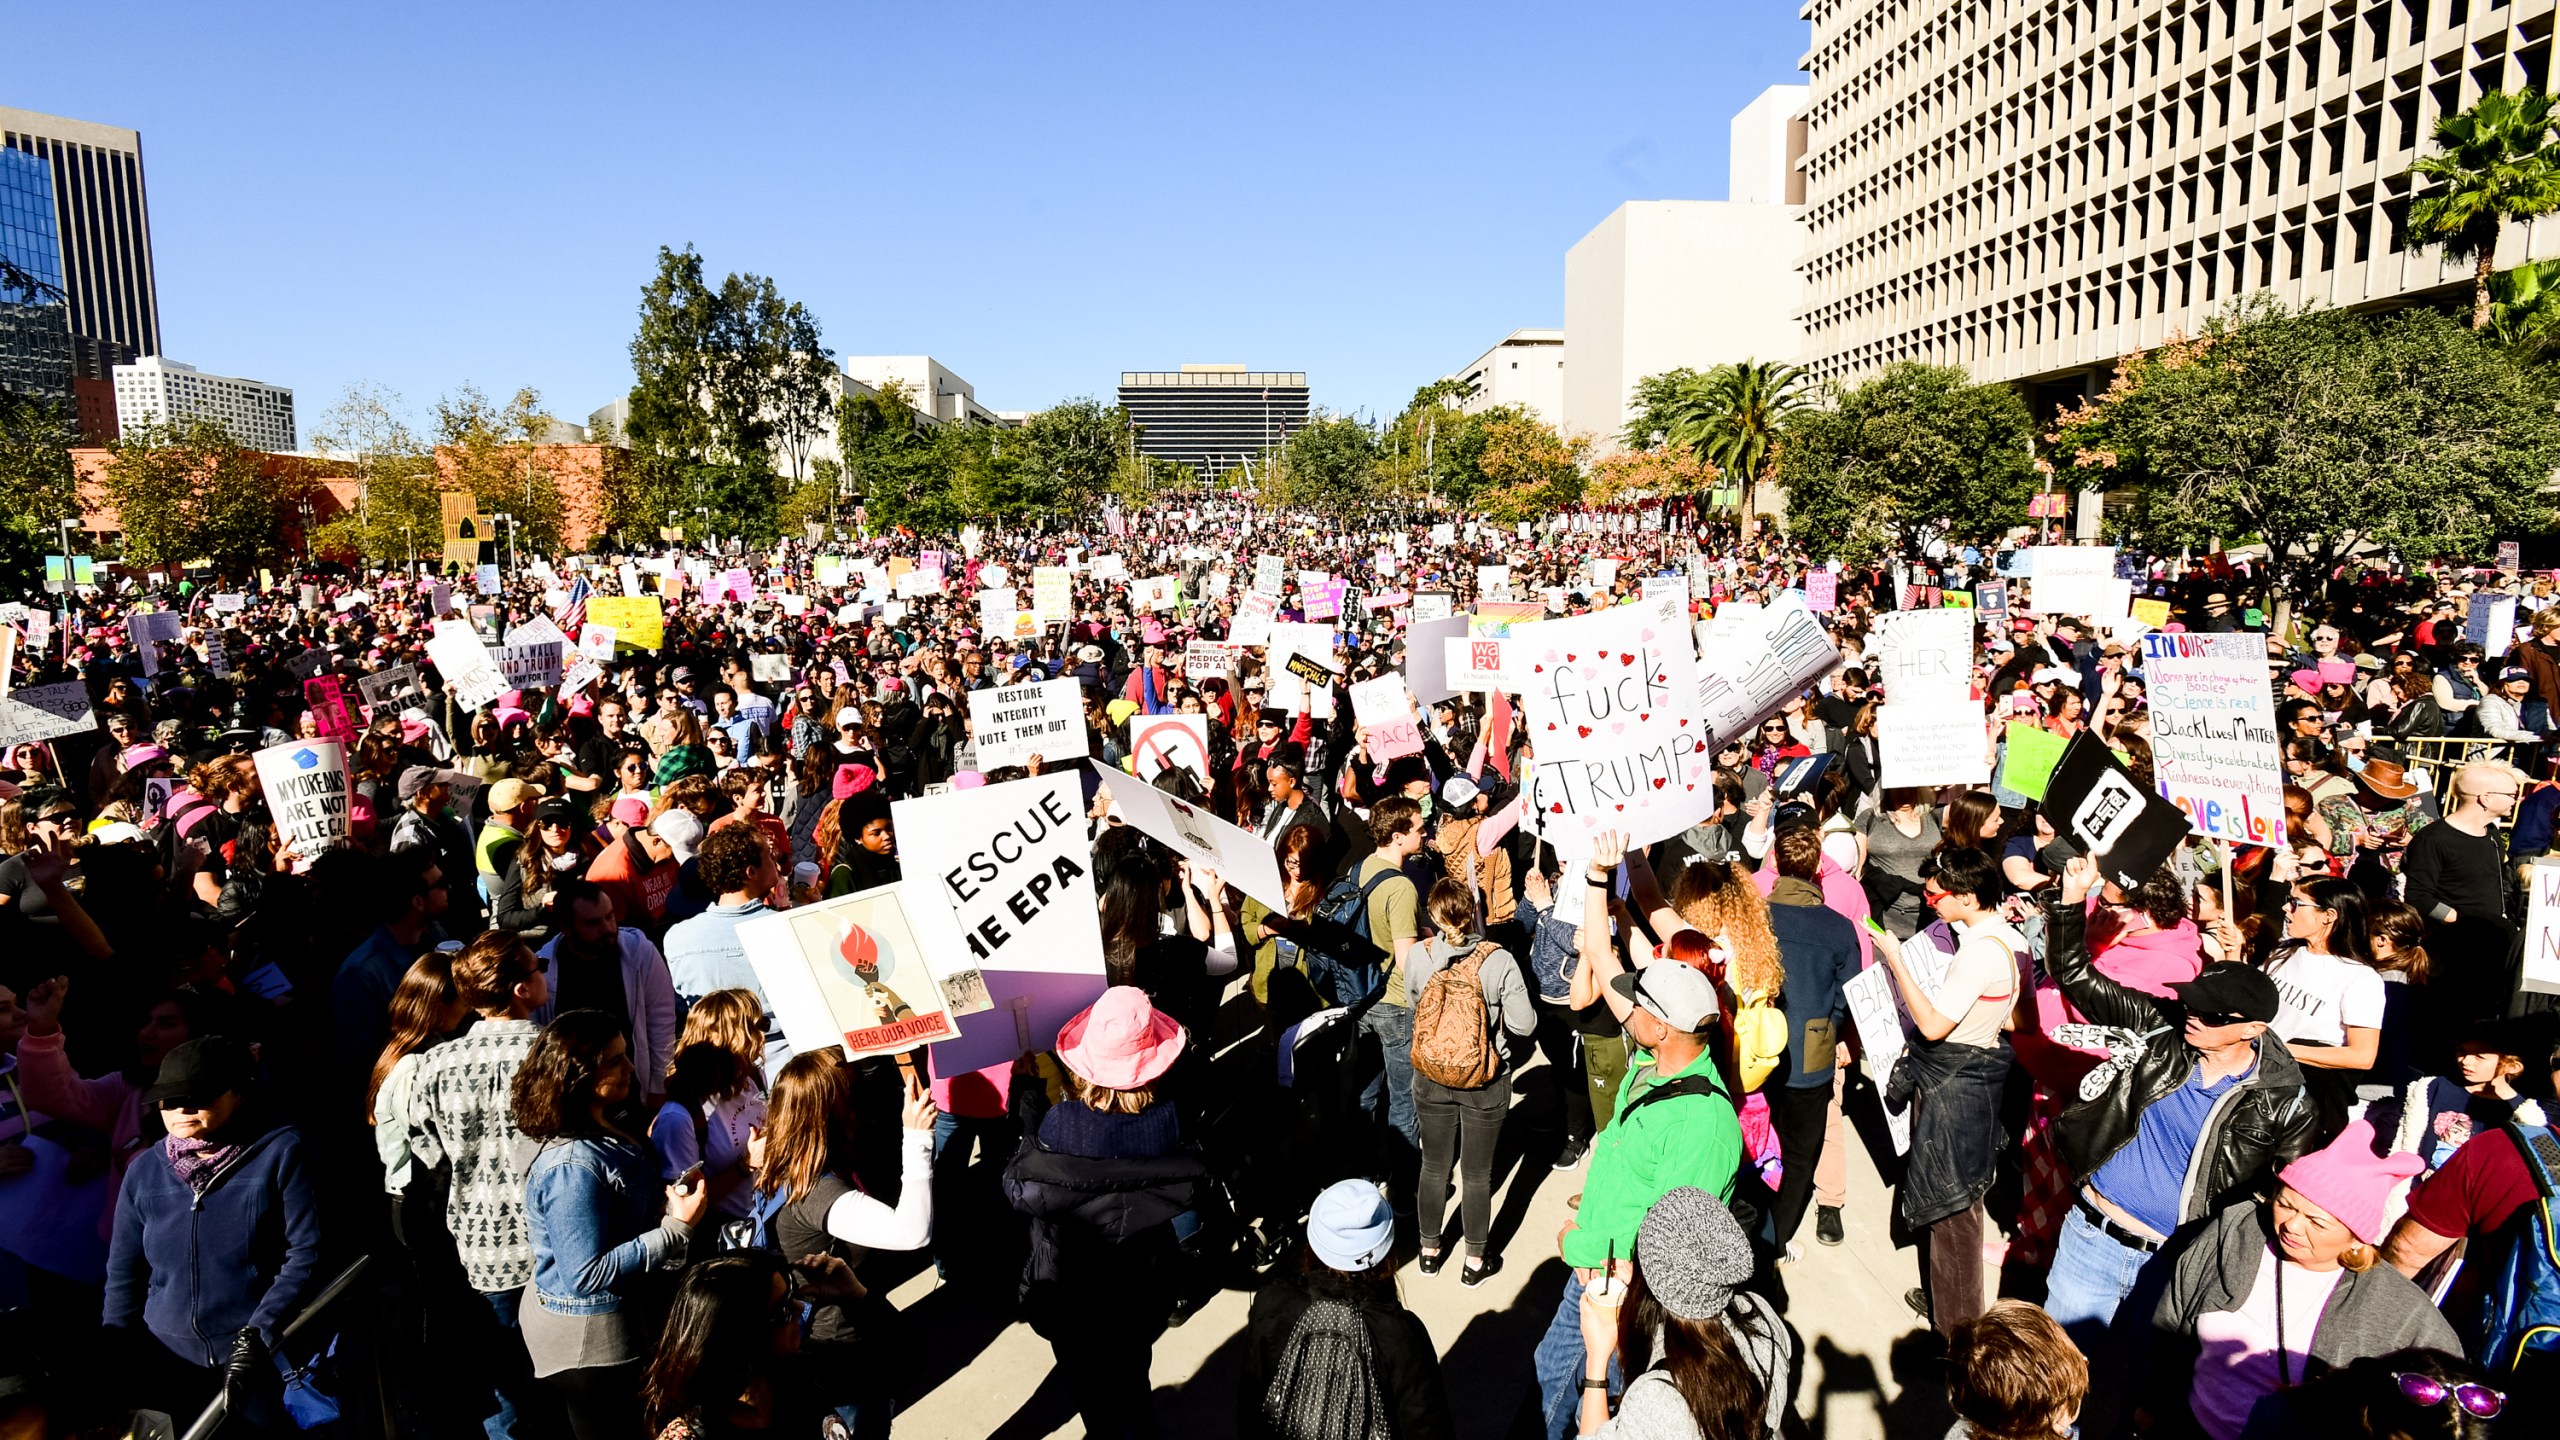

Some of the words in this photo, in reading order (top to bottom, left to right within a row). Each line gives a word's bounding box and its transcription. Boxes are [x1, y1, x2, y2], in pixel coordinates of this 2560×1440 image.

[1303, 584, 1325, 594] STOP
[1305, 591, 1330, 602] RAIDS
[489, 648, 517, 661] UILD
[519, 647, 525, 657] A
[530, 645, 555, 656] WALL
[1766, 609, 1832, 677] SUPPORT
[2143, 634, 2177, 658] IN
[2178, 635, 2206, 658] OUR
[525, 657, 561, 670] TRUMP!
[1470, 672, 1492, 680] Starts
[1898, 648, 1950, 678] HER
[2144, 660, 2182, 684] Women
[2184, 673, 2198, 682] are
[2199, 672, 2208, 682] in
[2239, 674, 2258, 684] their
[515, 675, 527, 684] PAY
[528, 674, 539, 682] FOR
[542, 672, 550, 681] IT
[1698, 673, 1734, 708] NOT
[2187, 682, 2226, 694] BODIES
[8, 686, 43, 703] LET'S
[46, 684, 74, 696] TALK
[13, 700, 46, 713] ABOUT
[47, 698, 65, 707] SEX
[372, 691, 428, 716] BROKEN
[996, 686, 1043, 704] RESTORE
[2154, 685, 2214, 710] Science
[2216, 697, 2224, 709] is
[2229, 696, 2258, 712] real
[992, 706, 1047, 724] INTEGRITY
[1719, 706, 1746, 728] JUST
[0, 731, 38, 746] CONSENT
[38, 730, 53, 738] AND
[53, 720, 94, 736] EQUALITY
[978, 728, 1007, 746] VOTE
[1014, 725, 1044, 740] THEM
[1048, 720, 1068, 736] OUT
[1366, 722, 1422, 754] DACA
[2232, 717, 2276, 744] MATTER
[2153, 737, 2214, 770] Diversity
[2214, 754, 2224, 765] is
[2224, 750, 2279, 772] celebrated
[276, 778, 298, 803] MY
[298, 770, 346, 797] DREAMS
[1540, 734, 1694, 815] TRUMP
[2157, 758, 2210, 786] Kindness
[2212, 775, 2221, 787] is
[2222, 774, 2282, 806] everything
[286, 801, 316, 824] ARE
[320, 796, 347, 815] NOT
[2225, 808, 2244, 838] is
[290, 817, 347, 845] ILLEGAL
[944, 791, 1072, 909] ESCUE
[642, 878, 664, 893] WEAR
[646, 888, 673, 910] ORAN
[966, 917, 1012, 960] HE
[1006, 854, 1084, 926] EPA
[1850, 962, 1900, 1024] BLACK
[850, 1029, 882, 1049] HEAR
[881, 1024, 907, 1043] OUR
[906, 1014, 944, 1036] VOICE
